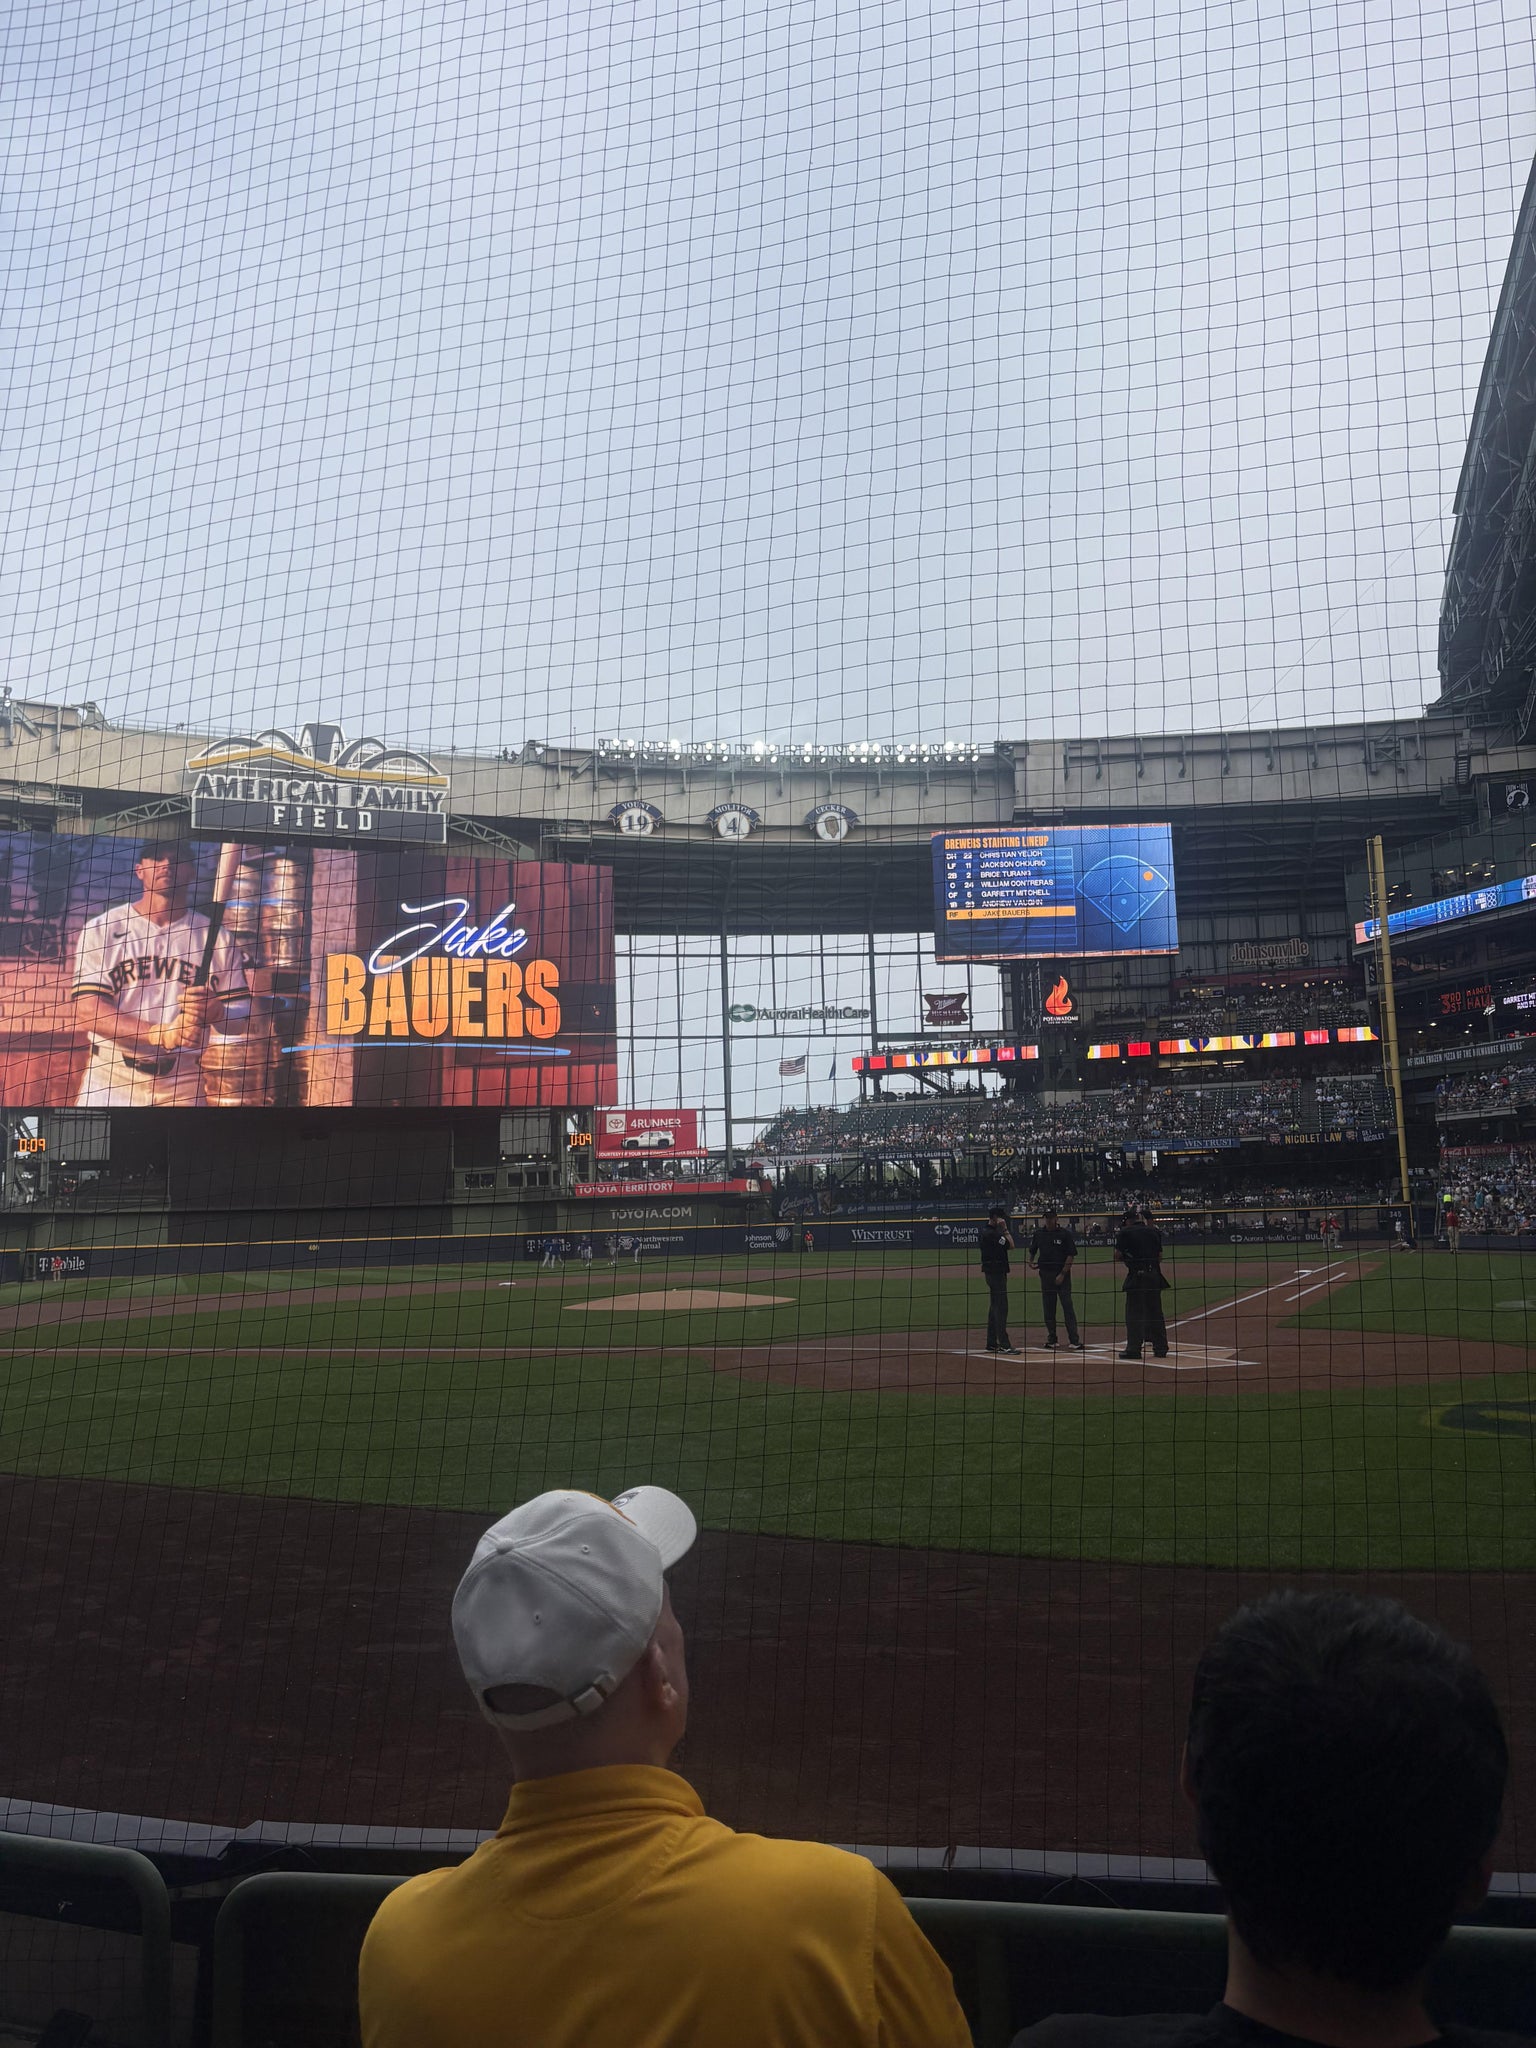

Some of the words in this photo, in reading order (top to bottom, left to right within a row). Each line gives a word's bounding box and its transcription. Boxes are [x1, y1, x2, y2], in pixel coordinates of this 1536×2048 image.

[194, 774, 339, 806] AMERICAN
[350, 784, 447, 813] FAMILY
[622, 801, 651, 812] YOUNT
[714, 805, 752, 816] MOLITOR
[815, 806, 847, 815] UECKER
[273, 805, 373, 831] FIELD
[624, 814, 648, 832] 19
[726, 817, 738, 833] 4
[944, 837, 981, 850] BREWERS
[982, 836, 1020, 848] STARTING
[1022, 835, 1049, 847] LINEUP
[979, 851, 1017, 859] CHRISTIAN
[981, 880, 1010, 888] WILLIAM
[1010, 879, 1054, 887] CONTRERAS
[1001, 909, 1031, 917] BAUERS
[369, 898, 528, 975] Jake
[1231, 938, 1309, 962] Johnsonville
[327, 953, 561, 1039] BAUERS
[1503, 993, 1528, 1005] GARRETT
[759, 1005, 800, 1020] Aurora
[843, 1004, 870, 1018] Care
[1426, 1055, 1443, 1064] FROZEN
[1443, 1052, 1456, 1061] PIZZA
[1456, 1051, 1462, 1059] OF
[1463, 1050, 1472, 1058] THE
[1472, 1045, 1499, 1057] MILWAUKEE
[630, 1118, 681, 1129] 4RUNNER
[1184, 1139, 1232, 1148] WINTRUST
[1285, 1133, 1321, 1144] NICOLET
[1324, 1131, 1343, 1143] LAW
[19, 1138, 45, 1152] 0:09
[991, 1146, 1015, 1157] 620
[1016, 1145, 1053, 1155] WTMJ
[578, 1184, 618, 1194] TOYOTA
[620, 1182, 674, 1193] TERRITORY
[610, 1206, 692, 1220] TOYOTA.COM
[852, 1229, 913, 1241] WINTRUST
[952, 1226, 979, 1235] Aurora
[745, 1234, 772, 1243] Johnson
[750, 1240, 778, 1249] Controls
[952, 1234, 978, 1243] Health
